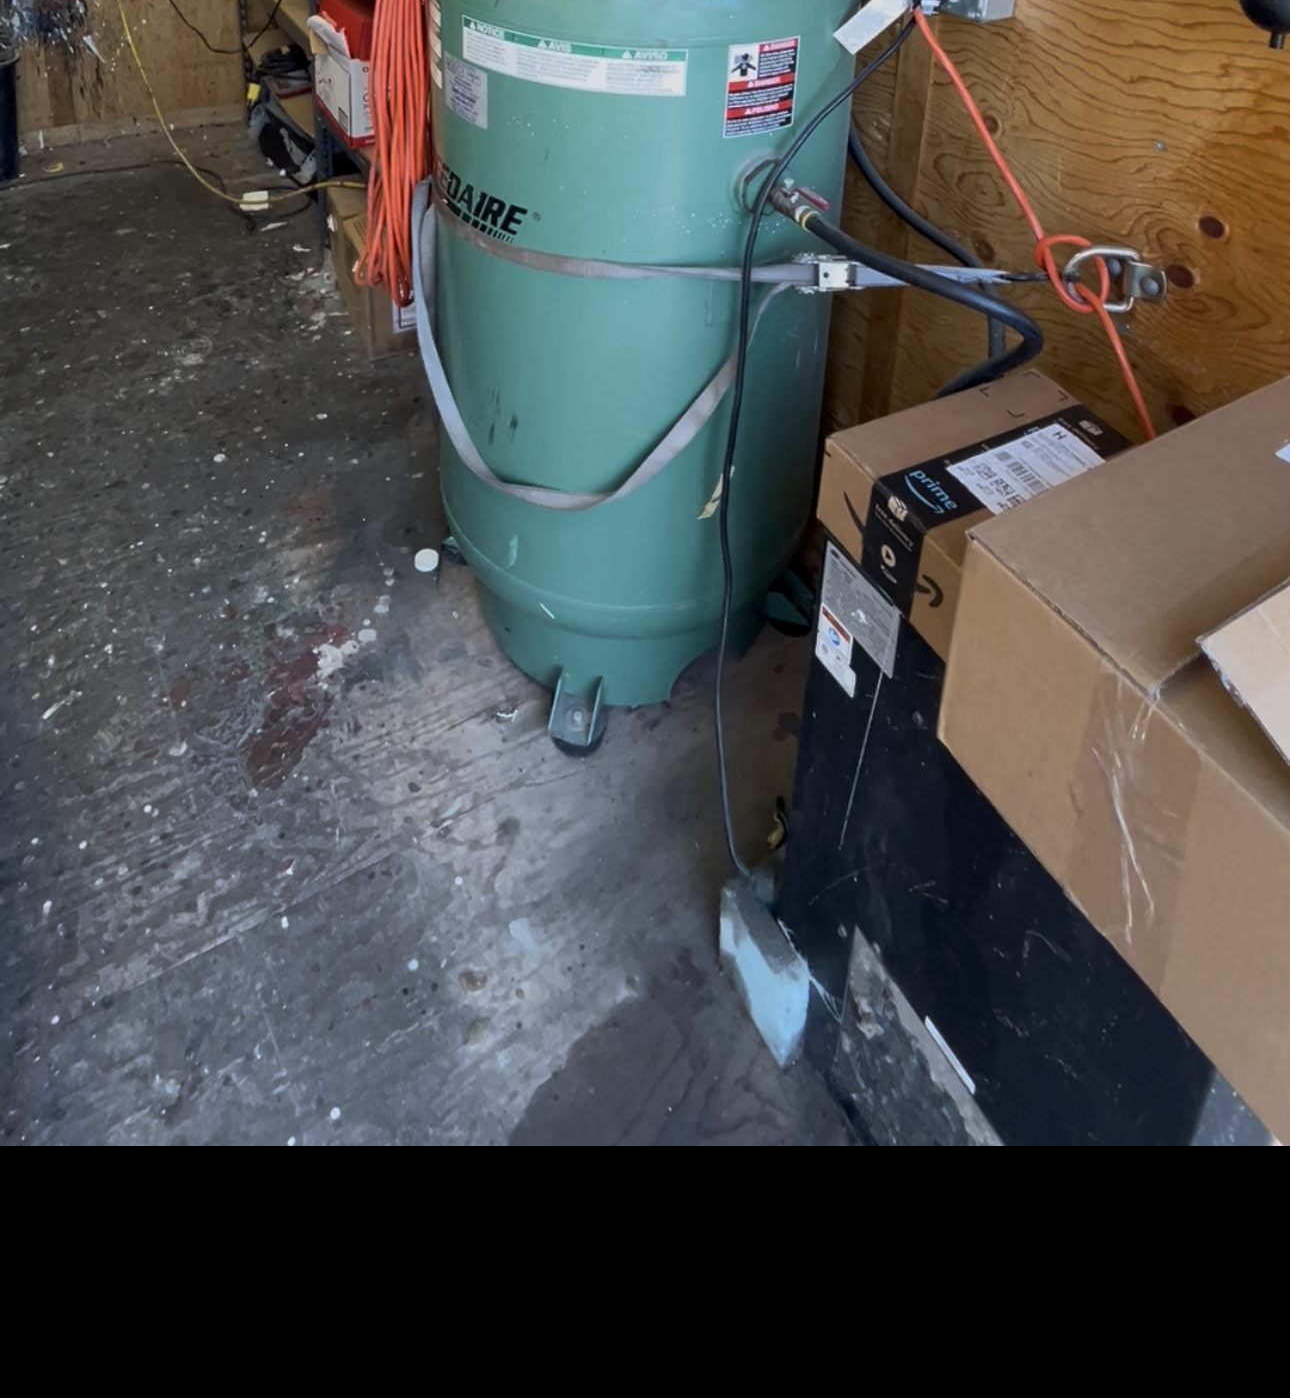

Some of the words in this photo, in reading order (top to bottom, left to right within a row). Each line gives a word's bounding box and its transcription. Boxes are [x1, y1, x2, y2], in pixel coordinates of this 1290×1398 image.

[477, 23, 504, 40] NOTICE
[548, 40, 572, 53] AVIS
[908, 470, 958, 511] prime
